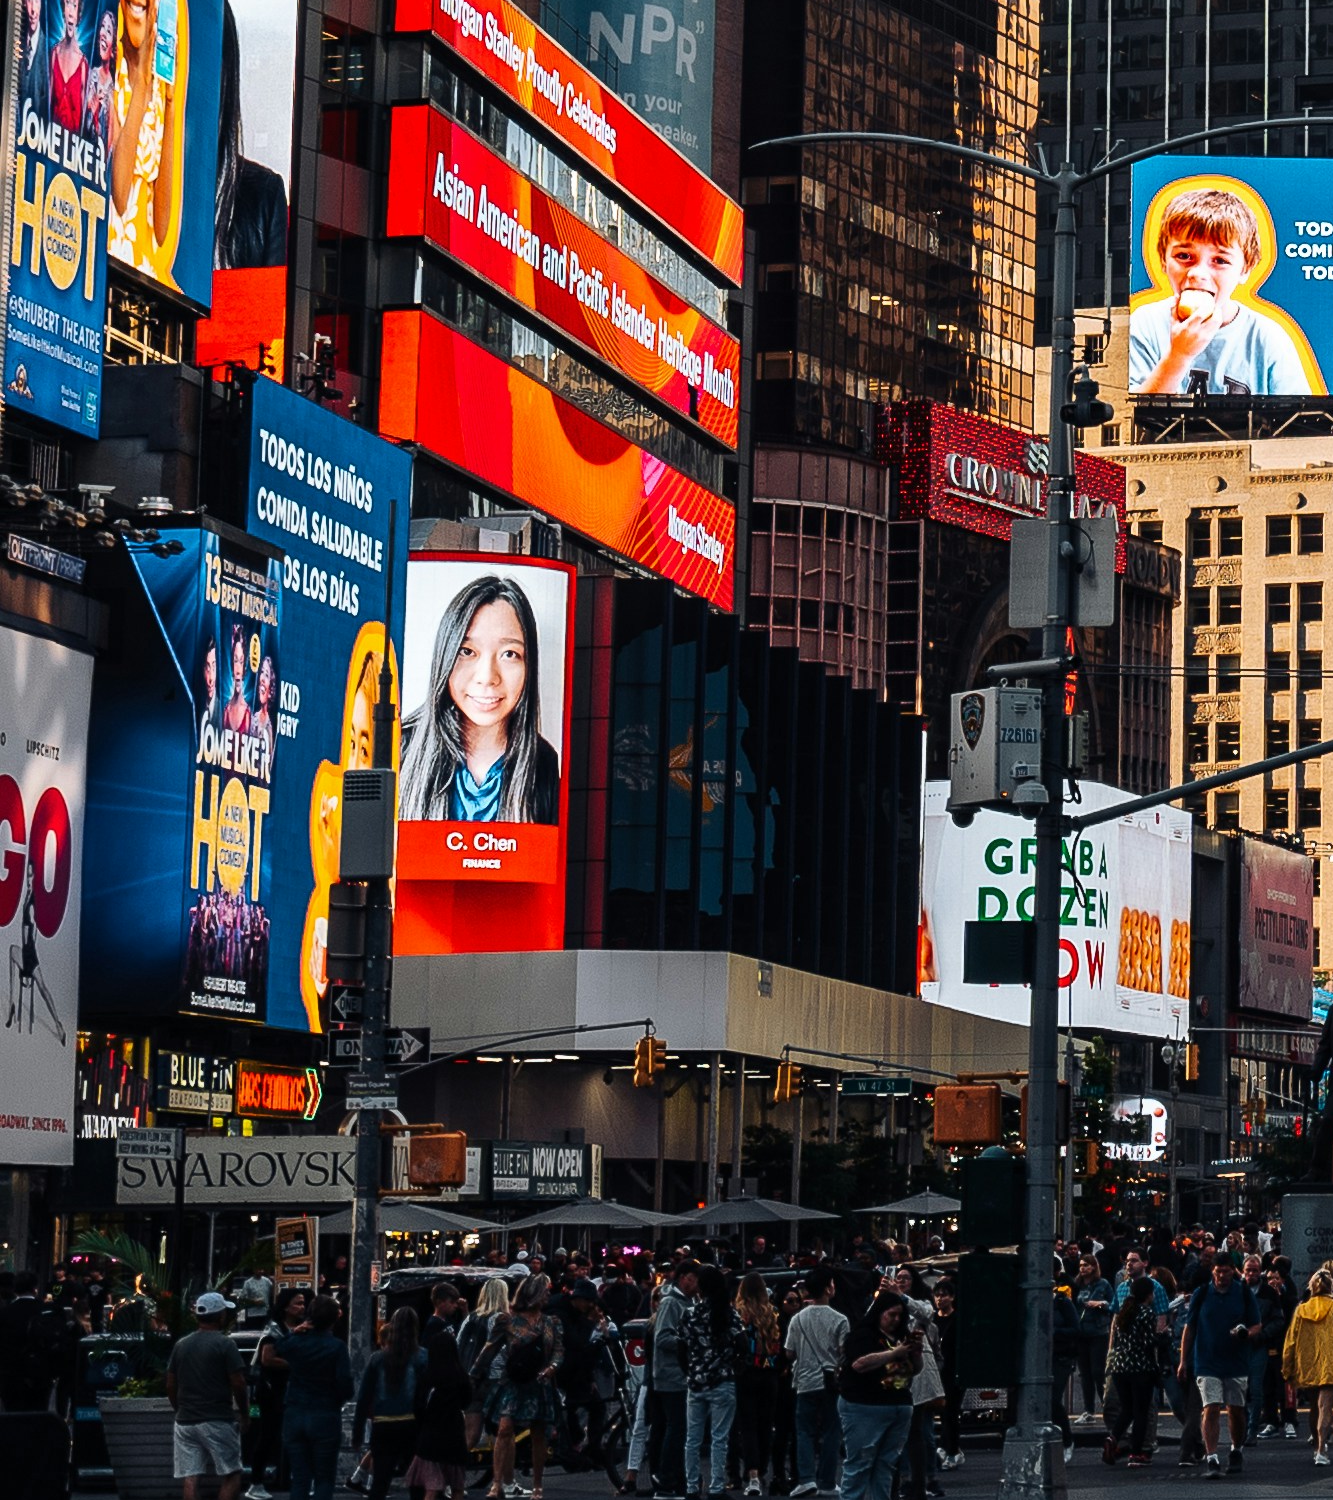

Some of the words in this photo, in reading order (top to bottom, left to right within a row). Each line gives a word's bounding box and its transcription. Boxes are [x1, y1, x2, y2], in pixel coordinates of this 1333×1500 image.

[484, 11, 525, 83] Stanley
[526, 49, 563, 117] Proudly
[565, 84, 617, 155] Celebrates
[644, 96, 682, 116] your
[16, 98, 62, 164] SOME
[9, 155, 106, 301] HOT
[46, 213, 78, 242] MUSICAL
[57, 198, 75, 220] NEW
[45, 235, 77, 264] COMEDY
[432, 152, 475, 223] Asian
[476, 184, 540, 272] American
[542, 240, 567, 289] and
[568, 250, 610, 320] Pacific
[611, 282, 656, 354] Islander
[657, 316, 703, 387] Heritage
[703, 352, 734, 409] Month
[9, 295, 60, 335] @SHUBERT
[61, 316, 101, 354] THEATRE
[259, 428, 304, 482] TODOS
[307, 452, 332, 496] LOS
[333, 464, 373, 514] NIÑOS
[949, 453, 1044, 511] CROWNE
[257, 486, 308, 545] COMIDA
[311, 514, 383, 573] SALUDABLE
[668, 504, 698, 558] Morgan
[697, 521, 725, 575] Stanley
[11, 537, 57, 575] OUTFRONT
[206, 551, 221, 604] 13
[302, 559, 327, 604] LOS
[330, 571, 360, 616] DÍAS
[221, 582, 241, 613] BEST
[242, 591, 279, 627] MUSICAL
[280, 681, 300, 713] KID
[196, 710, 232, 767] SOME
[1000, 727, 1038, 743] 726161
[190, 769, 271, 902] HOT
[220, 826, 246, 847] MUSICAL
[446, 832, 468, 851] C.
[473, 832, 517, 852] Chen
[219, 848, 247, 869] COMEDY
[462, 857, 501, 870] FINANCE
[1098, 841, 1108, 880] A
[978, 886, 1109, 930] DOZEN
[343, 1041, 362, 1055] ON
[170, 1053, 205, 1088] BLUE
[858, 1082, 867, 1091] W
[871, 1082, 881, 1091] 47
[121, 1150, 356, 1190] SWAROVSK
[494, 1153, 514, 1175] BLUE
[516, 1153, 530, 1175] FIN
[533, 1147, 556, 1177] NOW
[557, 1148, 583, 1178] OPEN
